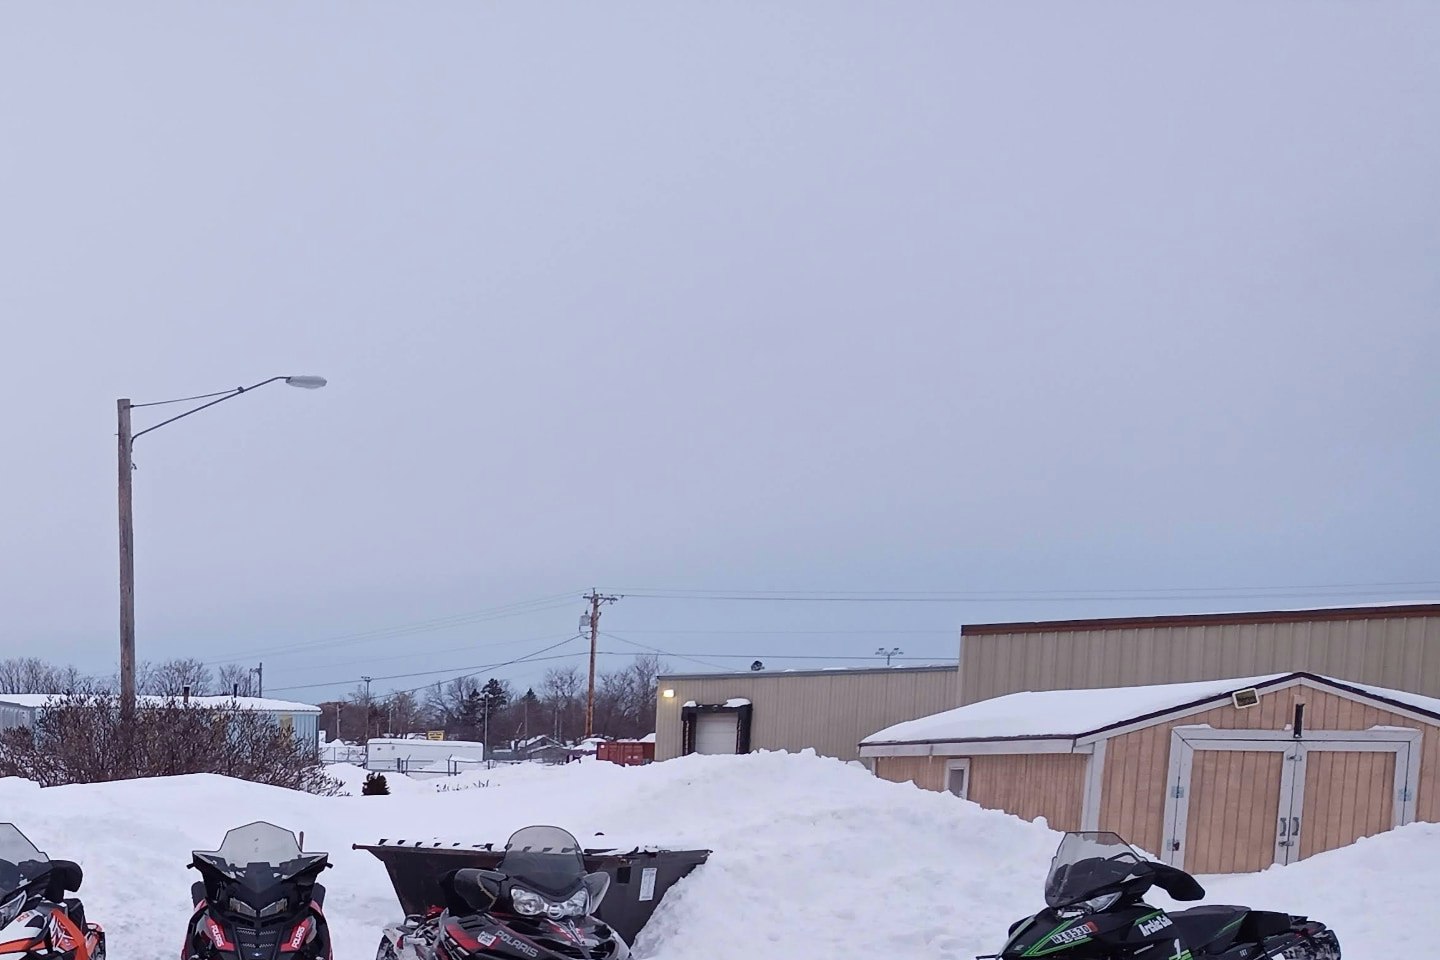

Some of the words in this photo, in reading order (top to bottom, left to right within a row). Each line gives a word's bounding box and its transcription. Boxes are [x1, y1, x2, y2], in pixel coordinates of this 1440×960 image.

[211, 925, 225, 947] POLARIS
[291, 925, 306, 948] POLARIS
[495, 929, 539, 958] POLARIS
